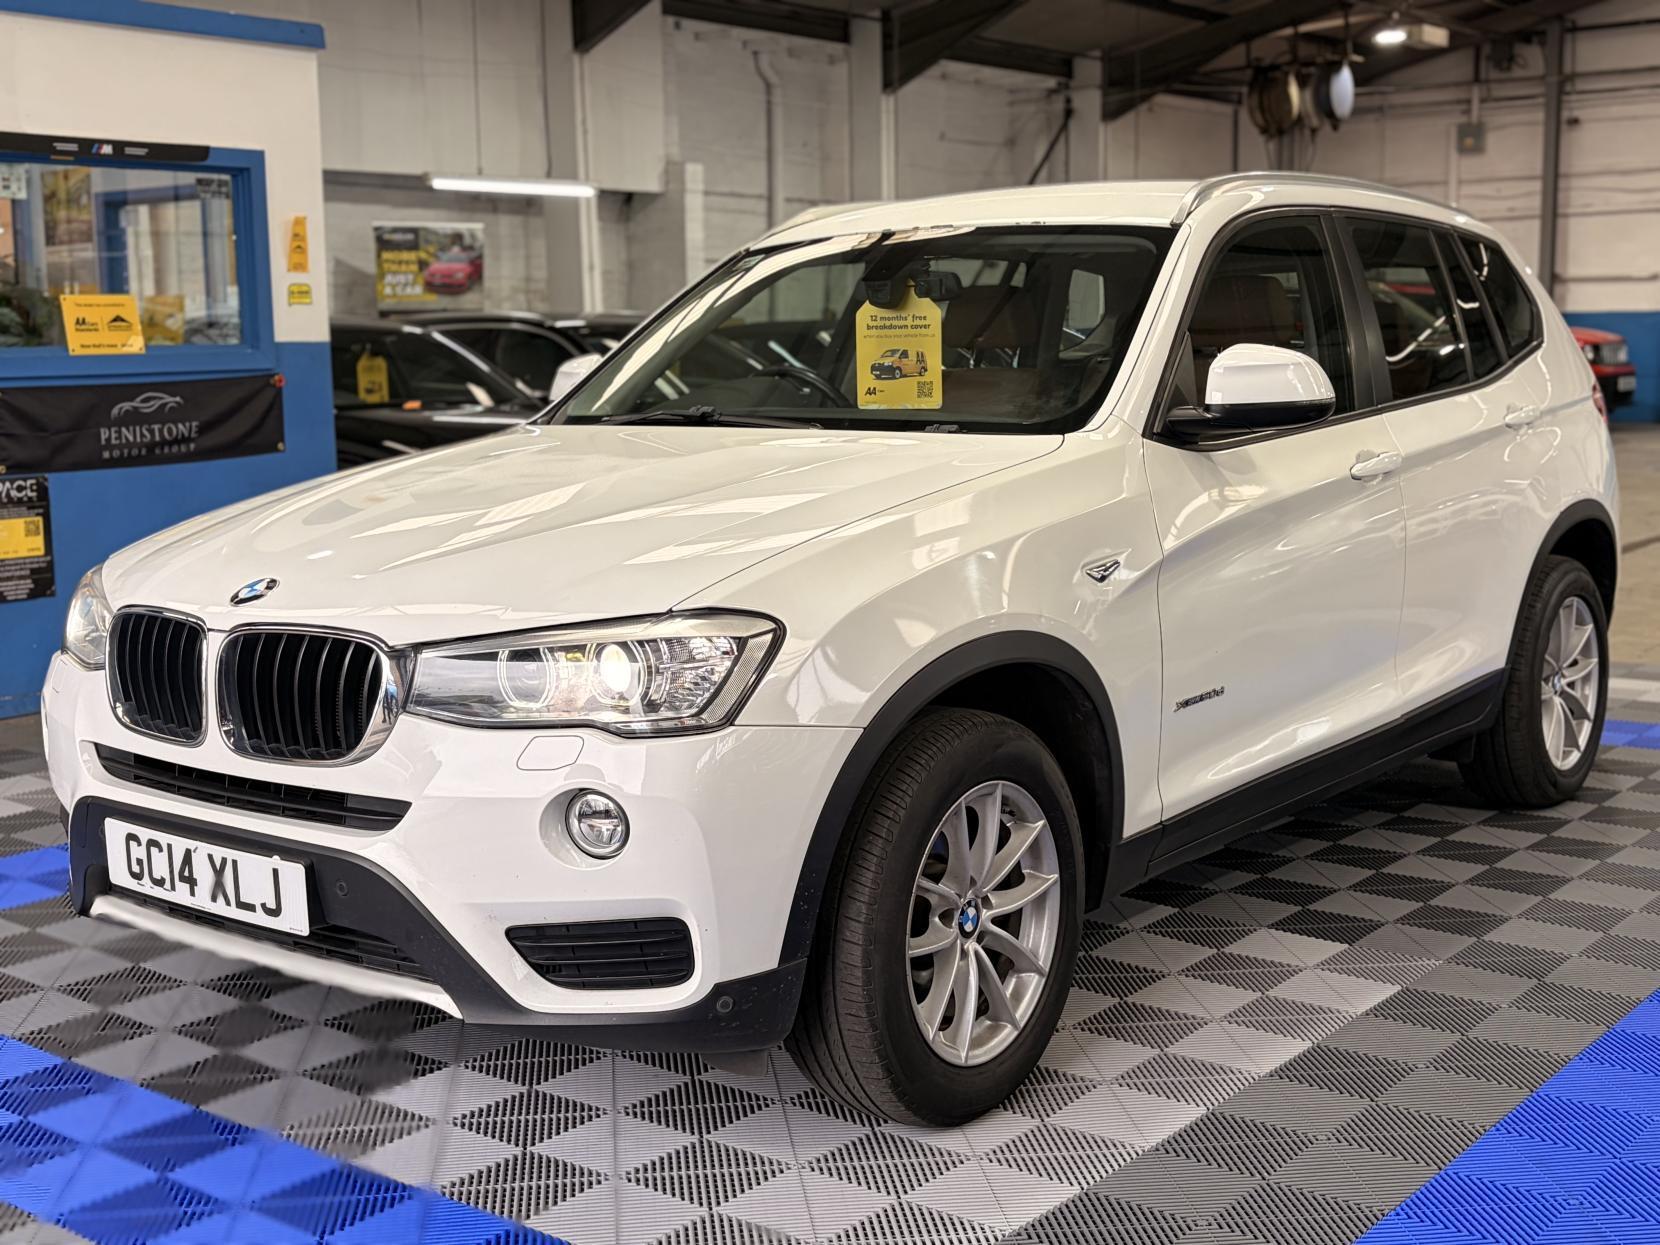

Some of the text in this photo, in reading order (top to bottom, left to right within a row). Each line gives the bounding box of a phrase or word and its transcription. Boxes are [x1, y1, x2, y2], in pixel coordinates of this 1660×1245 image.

[866, 323, 909, 331] breakdown
[912, 313, 927, 324] free
[864, 386, 877, 396] AA
[100, 421, 199, 445] PENISTONE
[102, 442, 196, 459] MOTOR GROUP
[0, 479, 37, 497] ACE
[125, 832, 282, 918] GC14 XLJ
